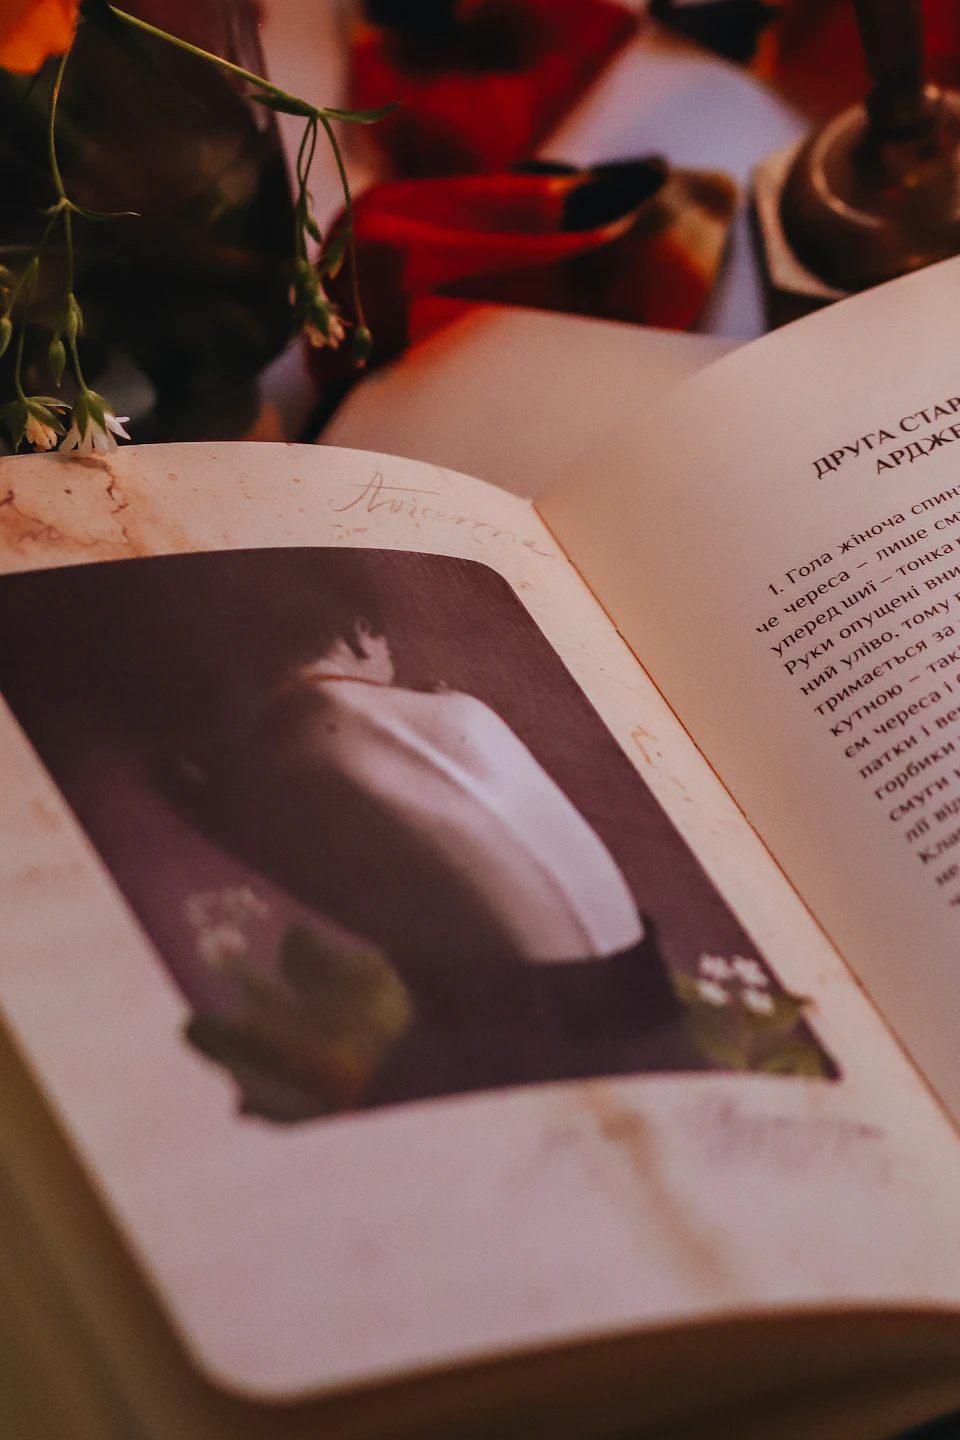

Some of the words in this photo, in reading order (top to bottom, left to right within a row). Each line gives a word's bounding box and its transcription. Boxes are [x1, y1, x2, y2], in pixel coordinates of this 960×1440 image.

[811, 429, 898, 480] ДРУГА
[755, 616, 780, 633] че
[782, 570, 851, 614] череса
[875, 528, 928, 562] лише
[767, 583, 784, 596] 1.
[784, 552, 834, 585] Гола
[837, 513, 906, 555] жіноча
[770, 605, 843, 659] уперед
[839, 579, 878, 609] шиї
[894, 543, 955, 576] тонка
[782, 638, 835, 676] Руки
[838, 585, 921, 640] опущені
[799, 664, 839, 696] ний
[839, 631, 900, 671] уліво,
[900, 598, 950, 630] тому
[813, 639, 929, 716] тримається
[931, 625, 956, 643] за
[829, 684, 903, 738] кутною
[844, 735, 872, 759] єм
[872, 690, 942, 735] череса
[943, 681, 954, 694] і
[858, 734, 919, 780] патки
[920, 724, 931, 737] і
[873, 741, 956, 801] горбики
